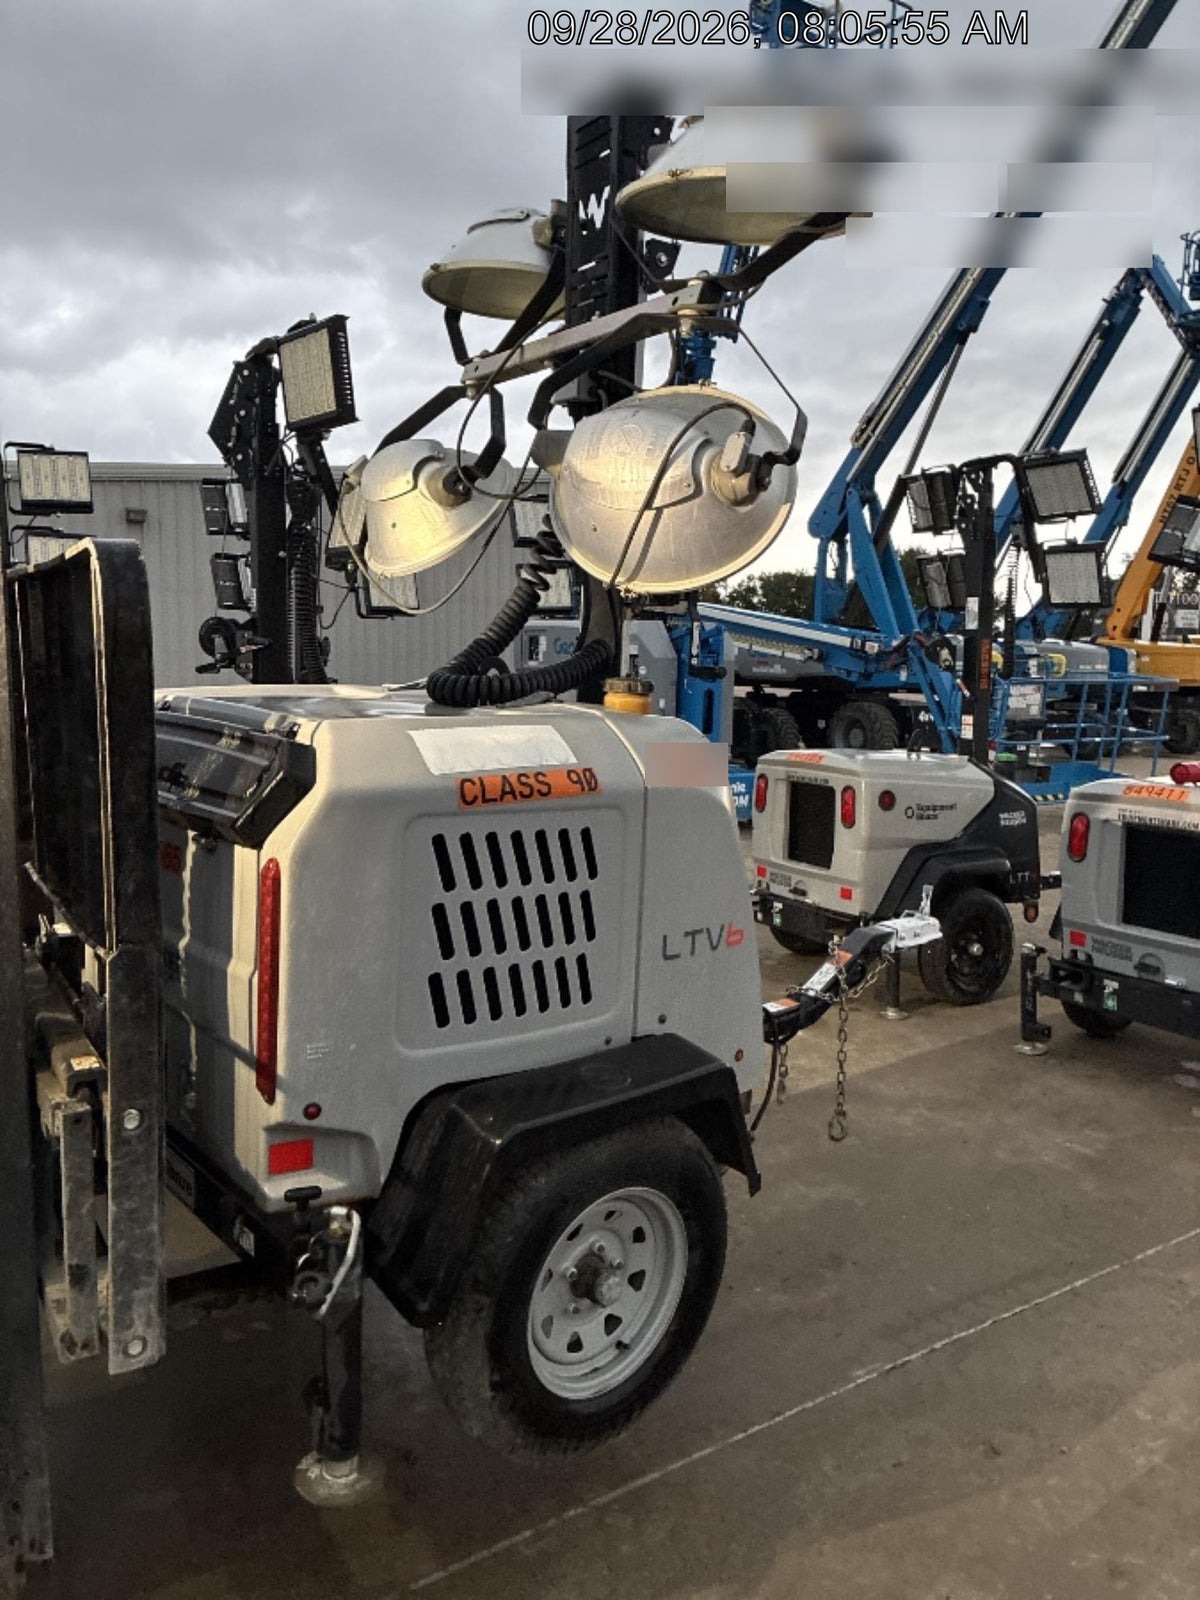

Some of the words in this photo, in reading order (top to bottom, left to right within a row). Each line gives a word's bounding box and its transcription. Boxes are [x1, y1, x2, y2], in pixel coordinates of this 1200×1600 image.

[459, 771, 552, 806] CLASS
[567, 767, 598, 792] 90
[662, 921, 744, 961] LTV6
